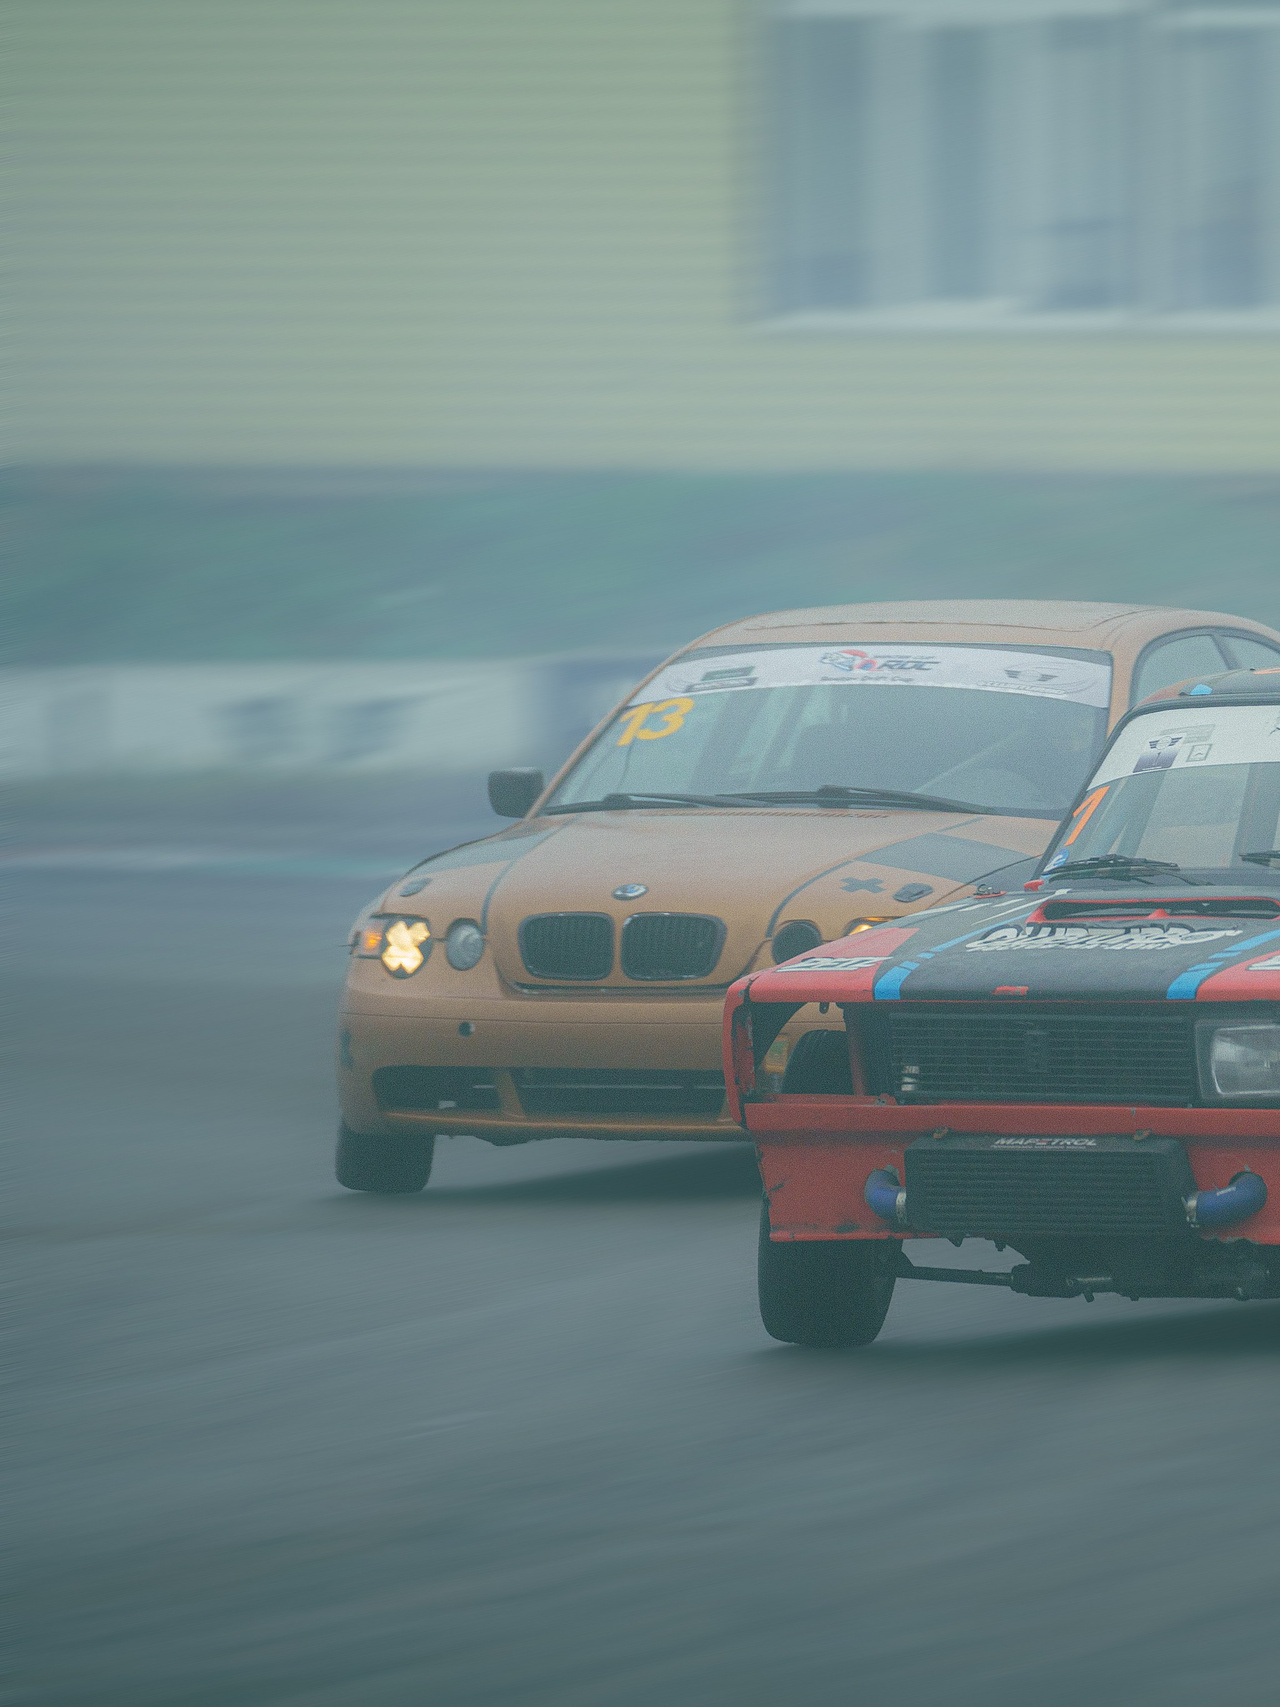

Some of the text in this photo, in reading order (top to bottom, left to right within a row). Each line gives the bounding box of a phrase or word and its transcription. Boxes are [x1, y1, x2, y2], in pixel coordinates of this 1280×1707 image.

[617, 697, 695, 747] 13
[1064, 785, 1110, 847] 1
[994, 1137, 1098, 1147] MAPETROL
